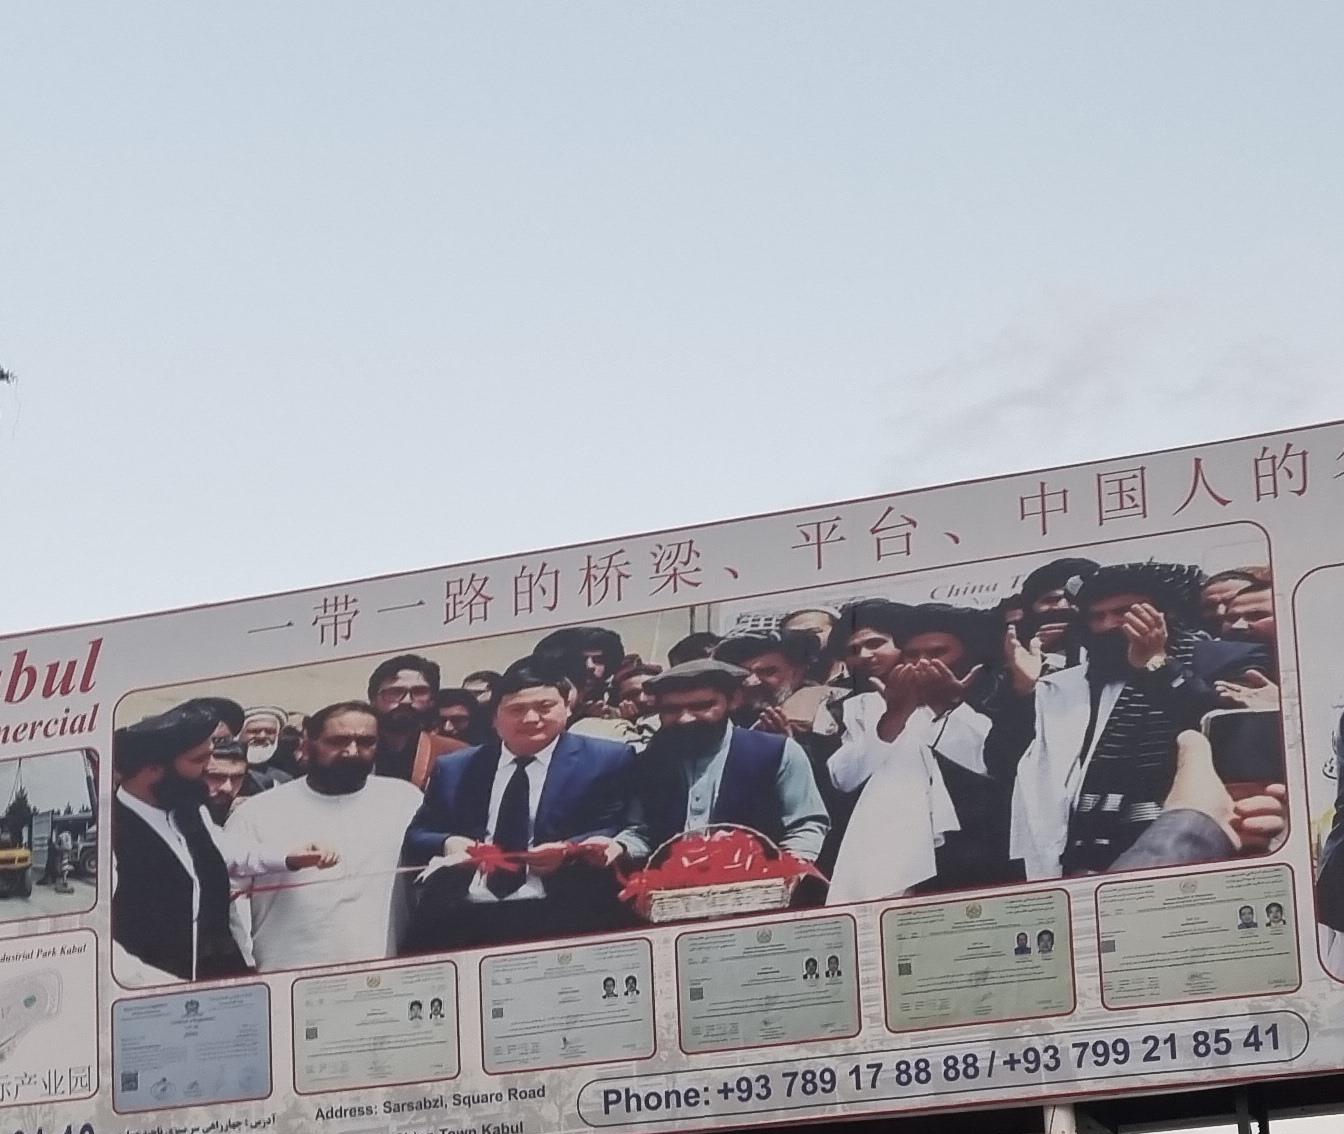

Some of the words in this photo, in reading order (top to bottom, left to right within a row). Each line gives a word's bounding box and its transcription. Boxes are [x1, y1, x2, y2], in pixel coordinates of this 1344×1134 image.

[35, 946, 57, 959] Park
[603, 1083, 711, 1116] Phone:
[716, 1074, 772, 1102] +93
[782, 1067, 837, 1098] 789
[848, 1062, 883, 1090] 17
[894, 1058, 932, 1087] 88
[942, 1053, 980, 1082] 88
[1002, 1045, 1061, 1074] +93
[1071, 1038, 1131, 1069] 799
[1141, 1033, 1178, 1063] 21
[1192, 1028, 1232, 1057] 85
[1242, 1023, 1280, 1052] 41
[315, 1104, 378, 1121] Address:
[452, 1088, 503, 1109] Square
[507, 1085, 546, 1101] Road
